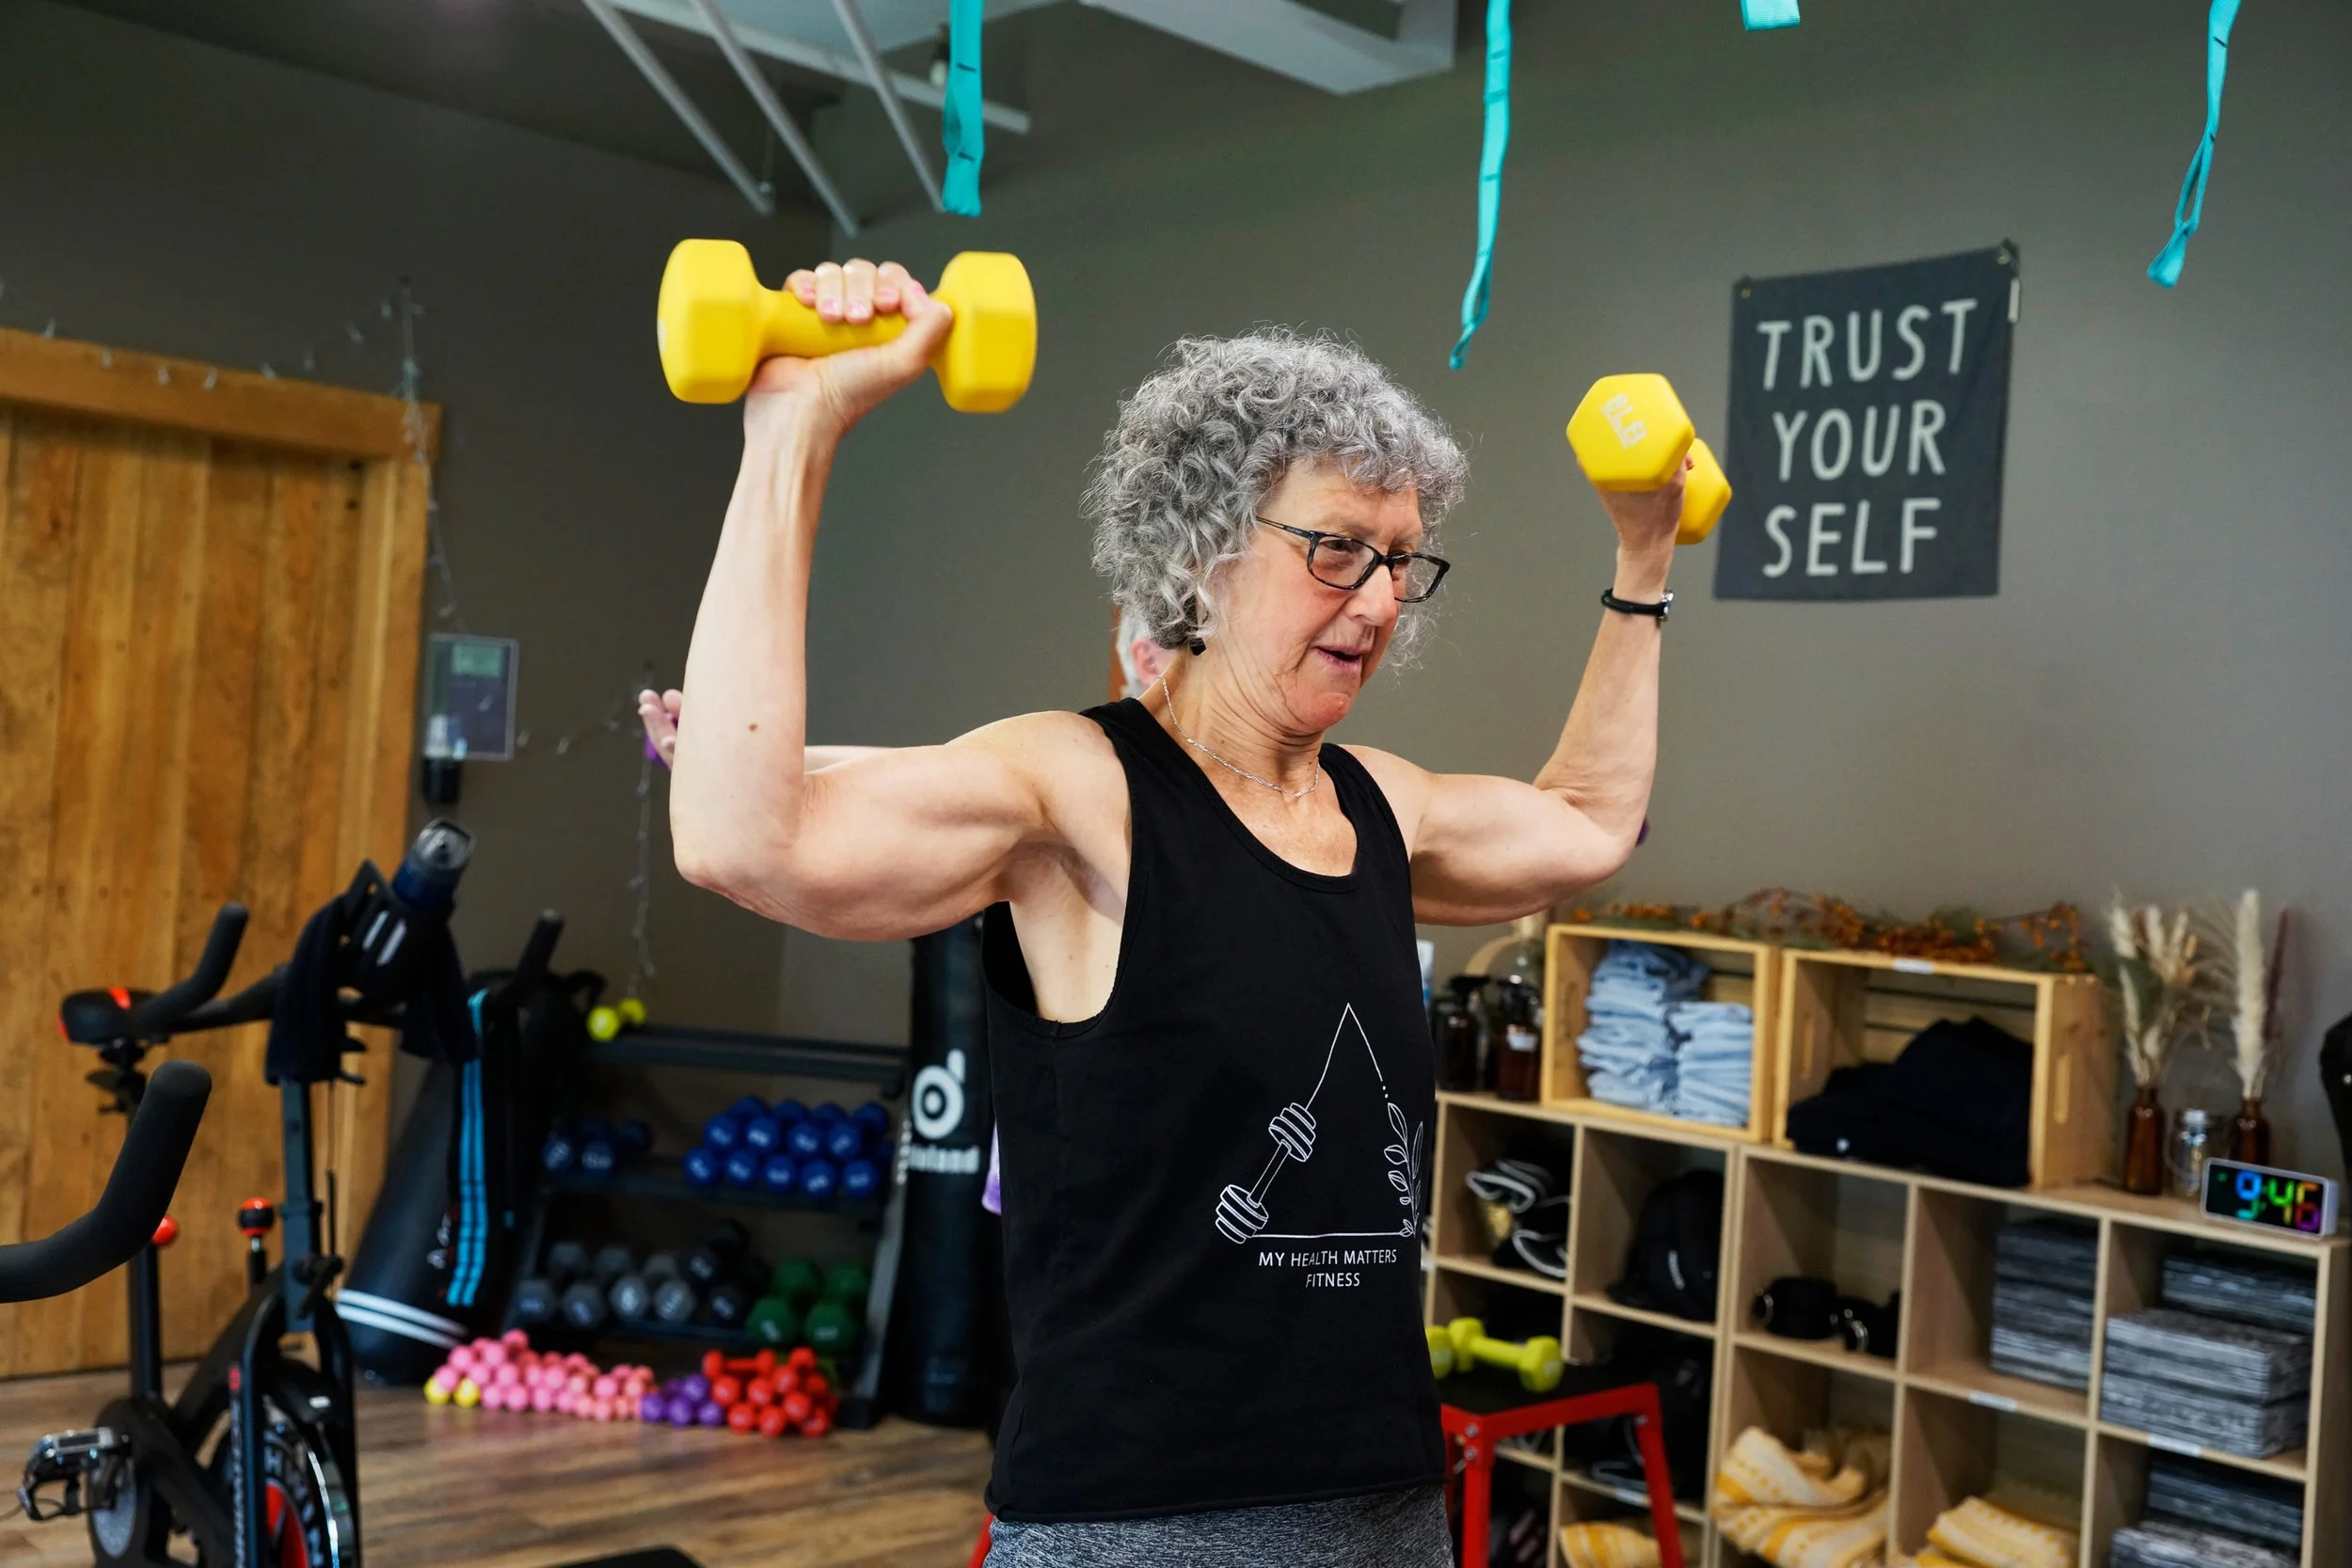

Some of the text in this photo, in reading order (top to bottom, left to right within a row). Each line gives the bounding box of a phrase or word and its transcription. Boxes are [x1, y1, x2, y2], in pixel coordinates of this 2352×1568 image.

[1757, 298, 1978, 390] TRUST
[1772, 400, 1946, 482] YOUR
[1762, 498, 1942, 578] SELF
[1258, 1249, 1397, 1267] MY HEALTH MATTERS
[1305, 1272, 1360, 1289] FITNESS
